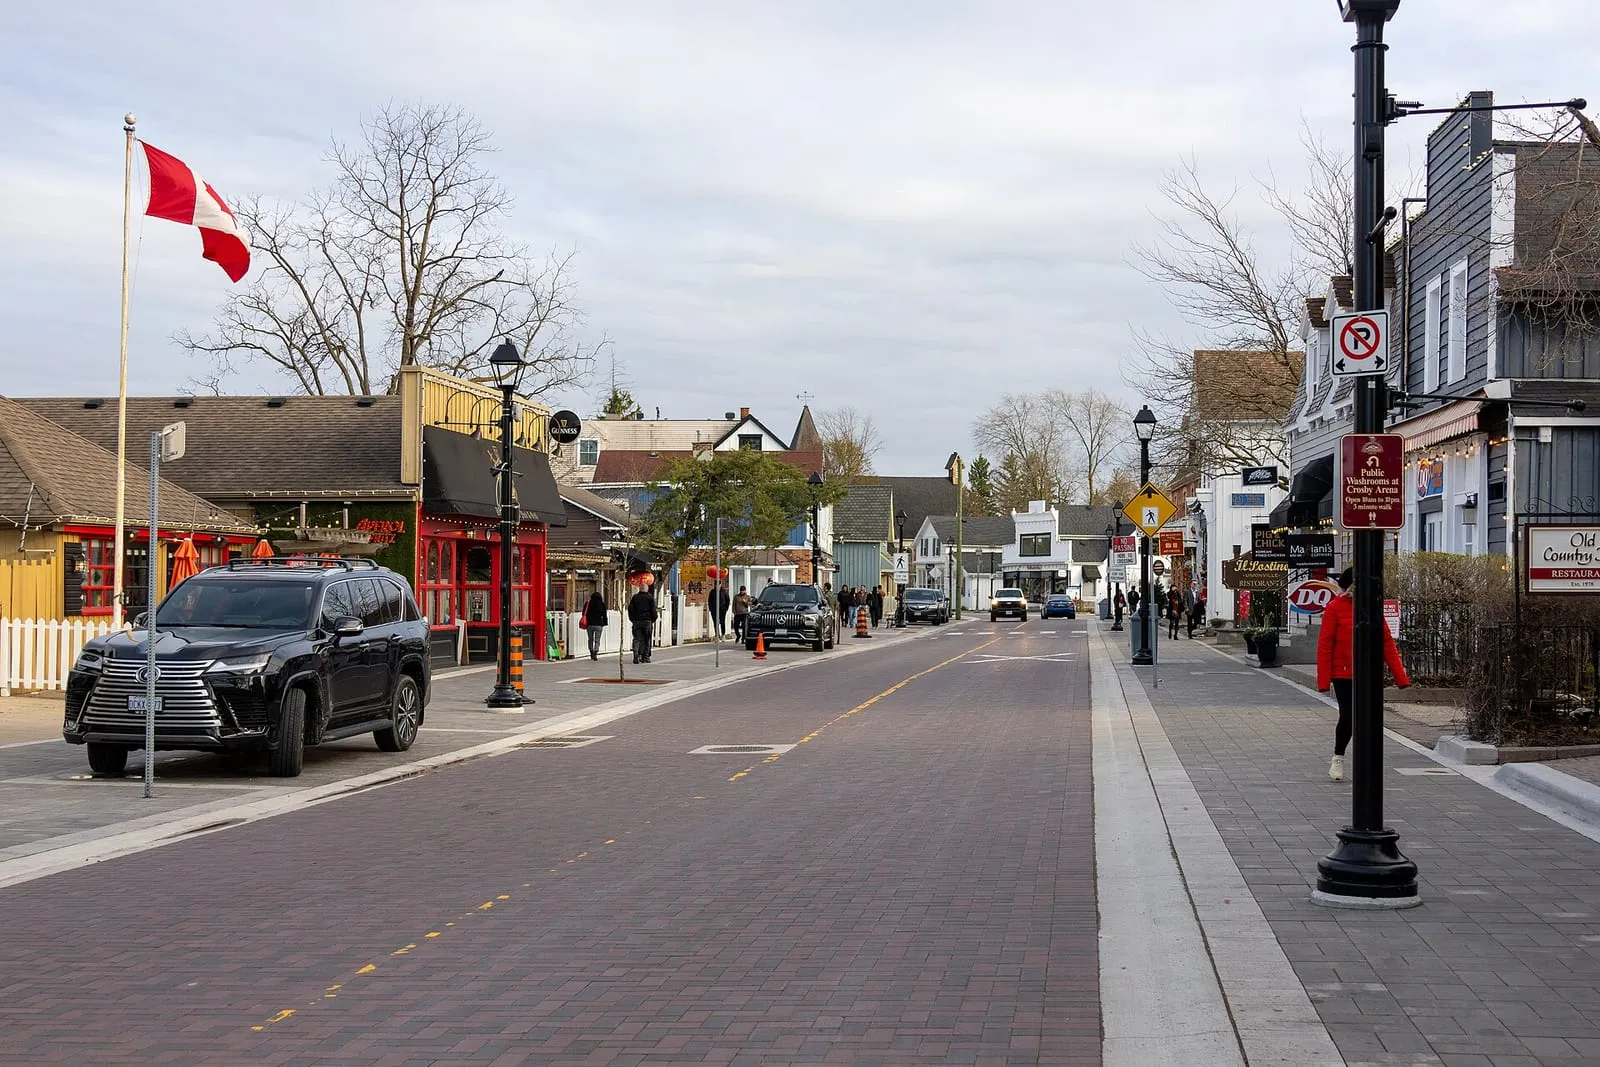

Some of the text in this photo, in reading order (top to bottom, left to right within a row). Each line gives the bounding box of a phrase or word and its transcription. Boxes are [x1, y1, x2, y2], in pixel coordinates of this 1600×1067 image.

[551, 427, 578, 435] GUINNESS
[1361, 468, 1385, 477] Public
[1346, 477, 1390, 485] Washrooms
[1346, 486, 1398, 495] Crosby Arena
[1255, 530, 1273, 539] PIG
[1255, 539, 1286, 548] CHICK
[1570, 532, 1596, 548] Old
[1114, 544, 1135, 552] PASSING
[1543, 546, 1593, 566] Country
[1296, 588, 1332, 607] DQ
